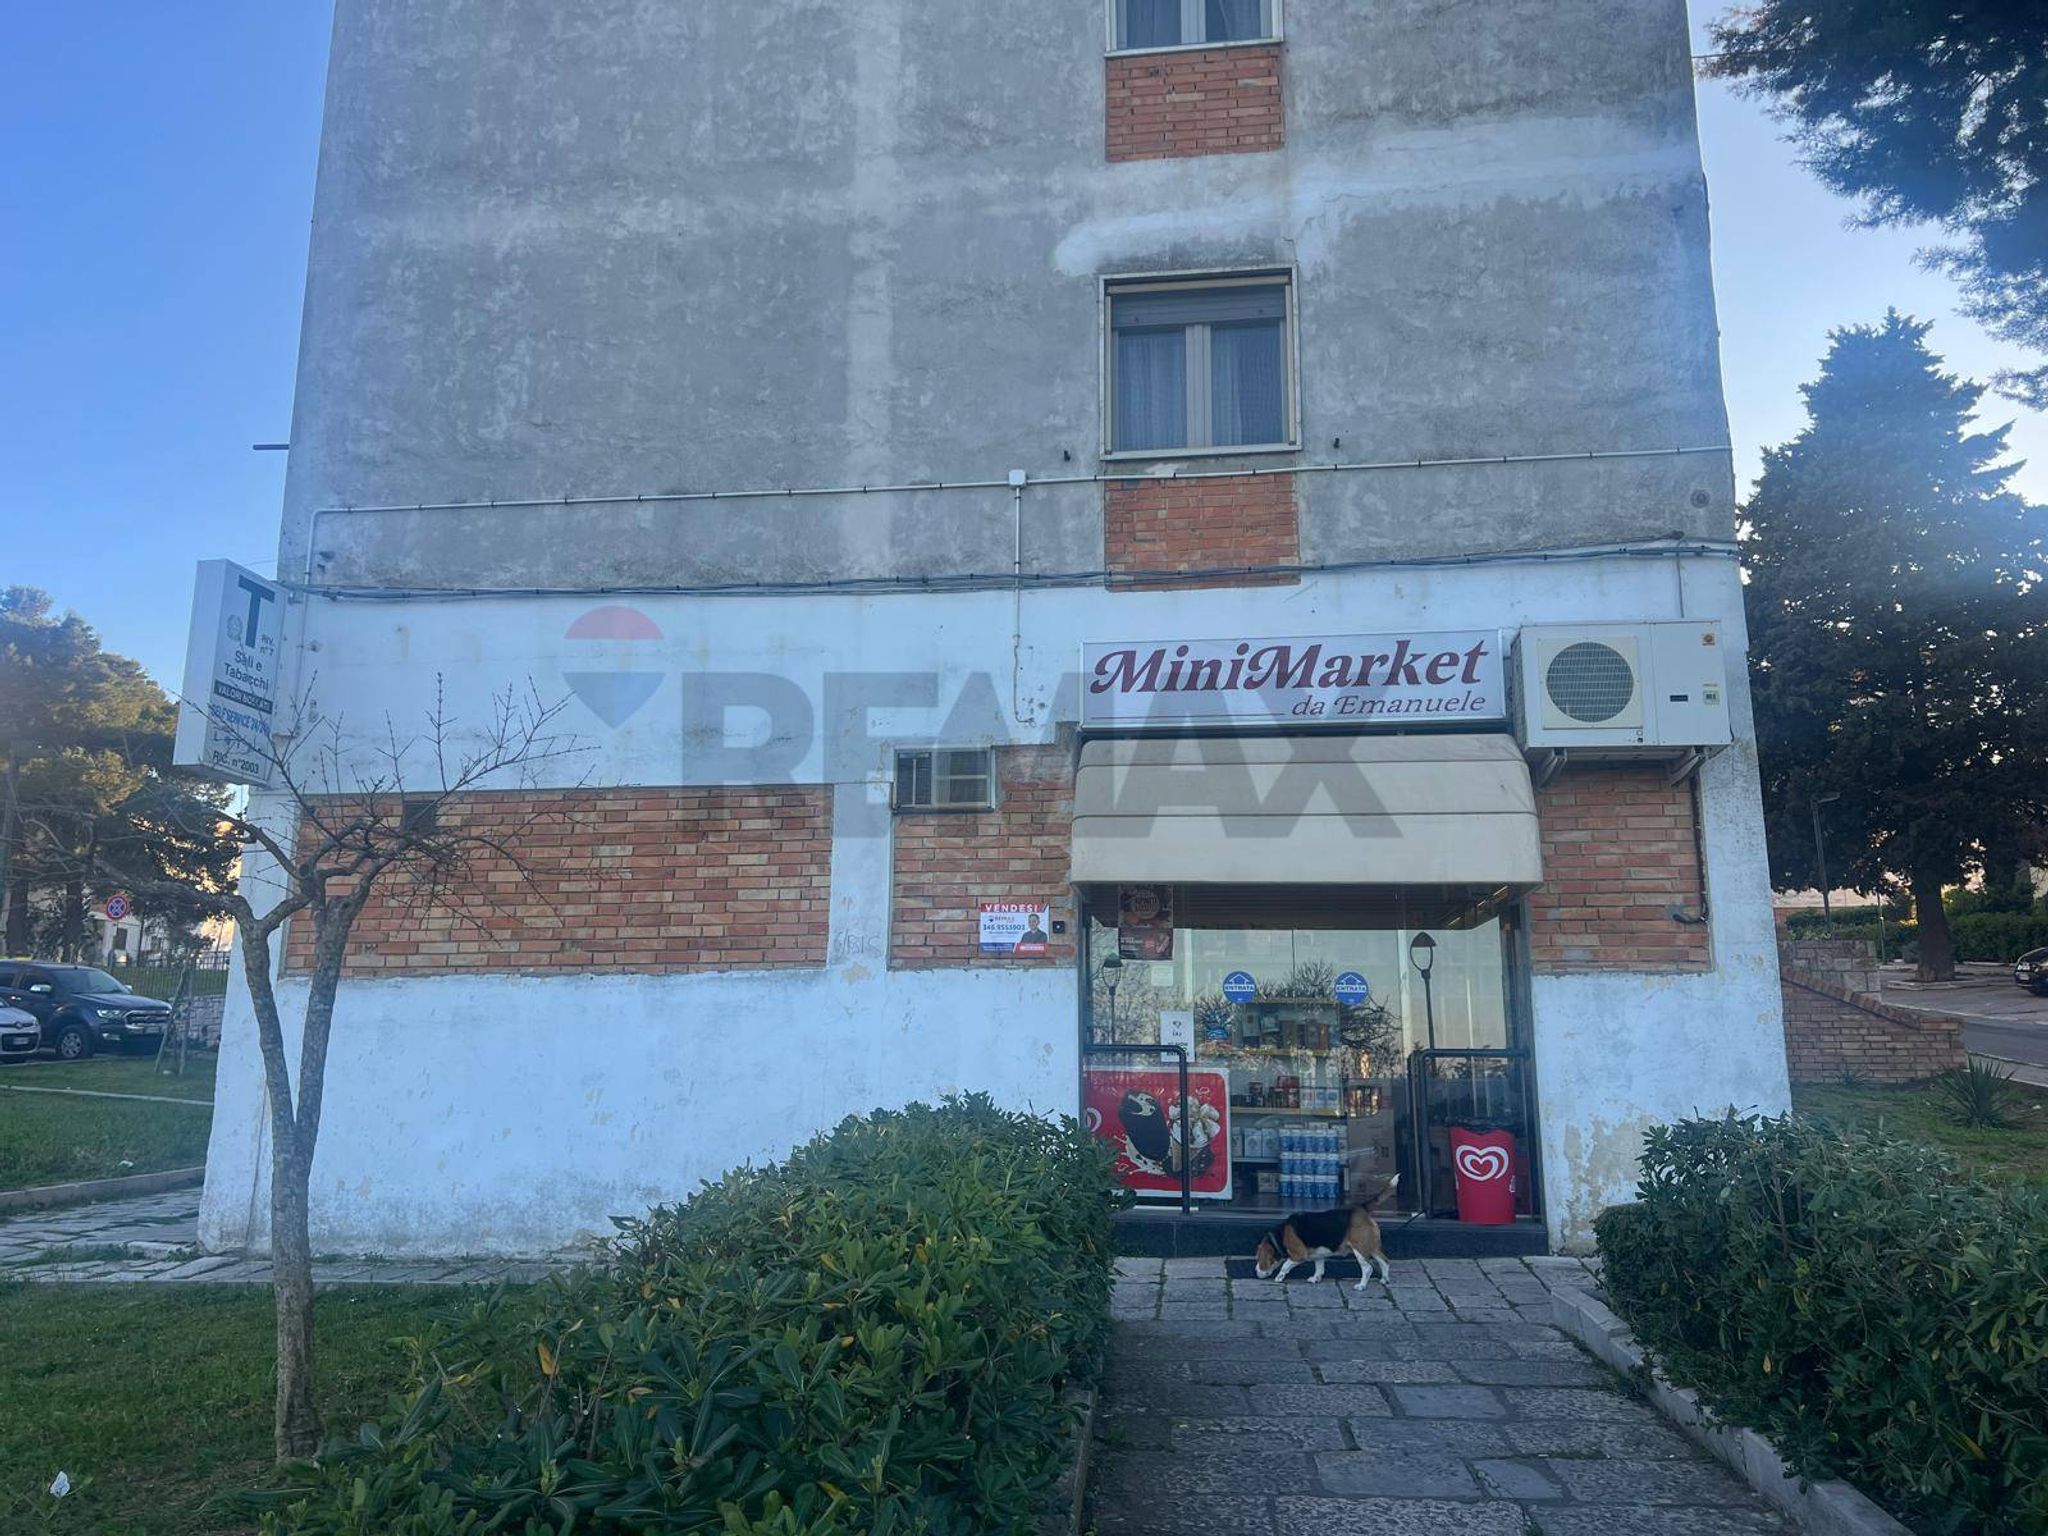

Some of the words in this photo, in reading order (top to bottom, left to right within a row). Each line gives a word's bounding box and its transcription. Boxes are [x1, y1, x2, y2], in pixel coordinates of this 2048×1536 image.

[238, 574, 276, 648] T
[234, 650, 254, 668] Sali
[255, 661, 263, 672] e
[1090, 640, 1489, 694] MiniMarket
[224, 662, 269, 692] Tabacchi
[1291, 694, 1325, 716] da
[1333, 690, 1486, 715] Emanuele
[985, 904, 1038, 913] VENDESI
[1224, 984, 1255, 992] ENTRATA
[1336, 984, 1366, 993] ENTRATA
